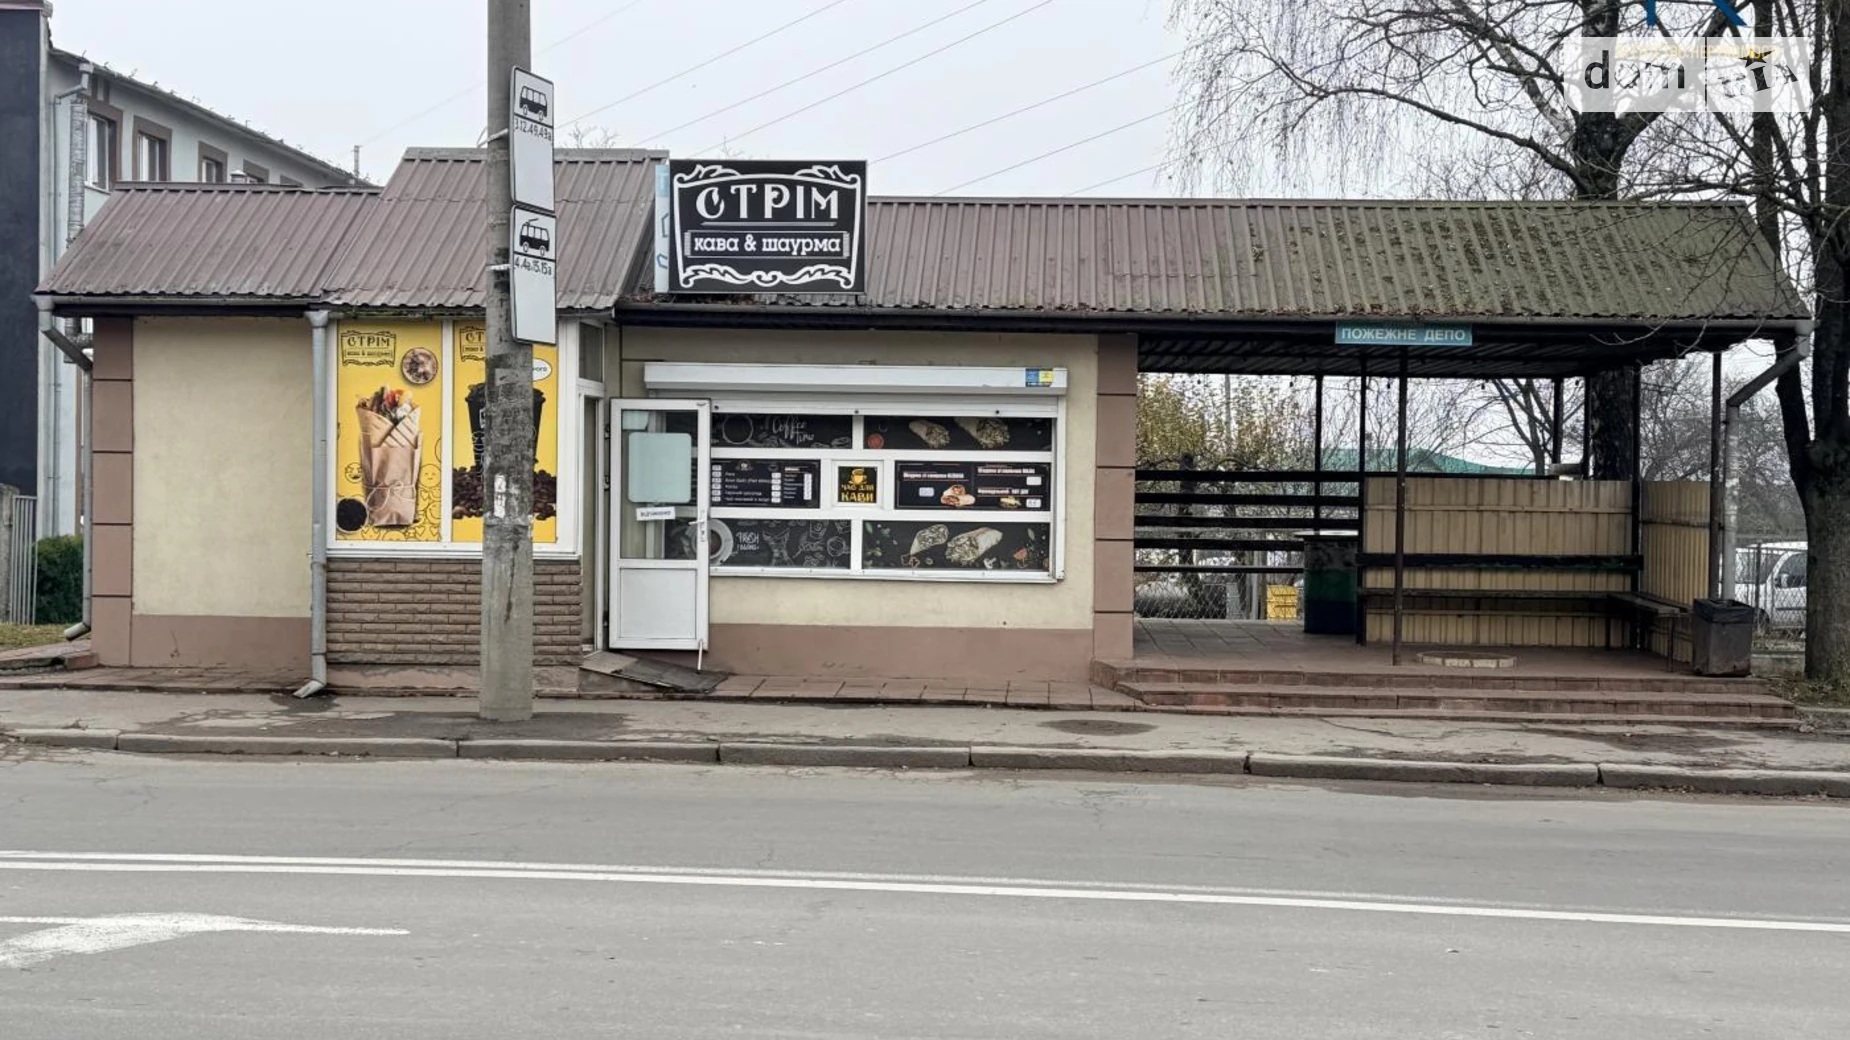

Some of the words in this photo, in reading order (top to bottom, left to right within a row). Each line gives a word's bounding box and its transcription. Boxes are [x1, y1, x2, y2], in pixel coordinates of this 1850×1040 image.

[696, 183, 838, 219] СТРІМ
[694, 237, 739, 252] кава
[744, 234, 757, 252] &
[762, 238, 841, 255] шаурма
[347, 336, 390, 346] СТРІМ
[1341, 328, 1417, 340] ПОЖЕЖНЕ
[1424, 329, 1466, 342] ДЕПО
